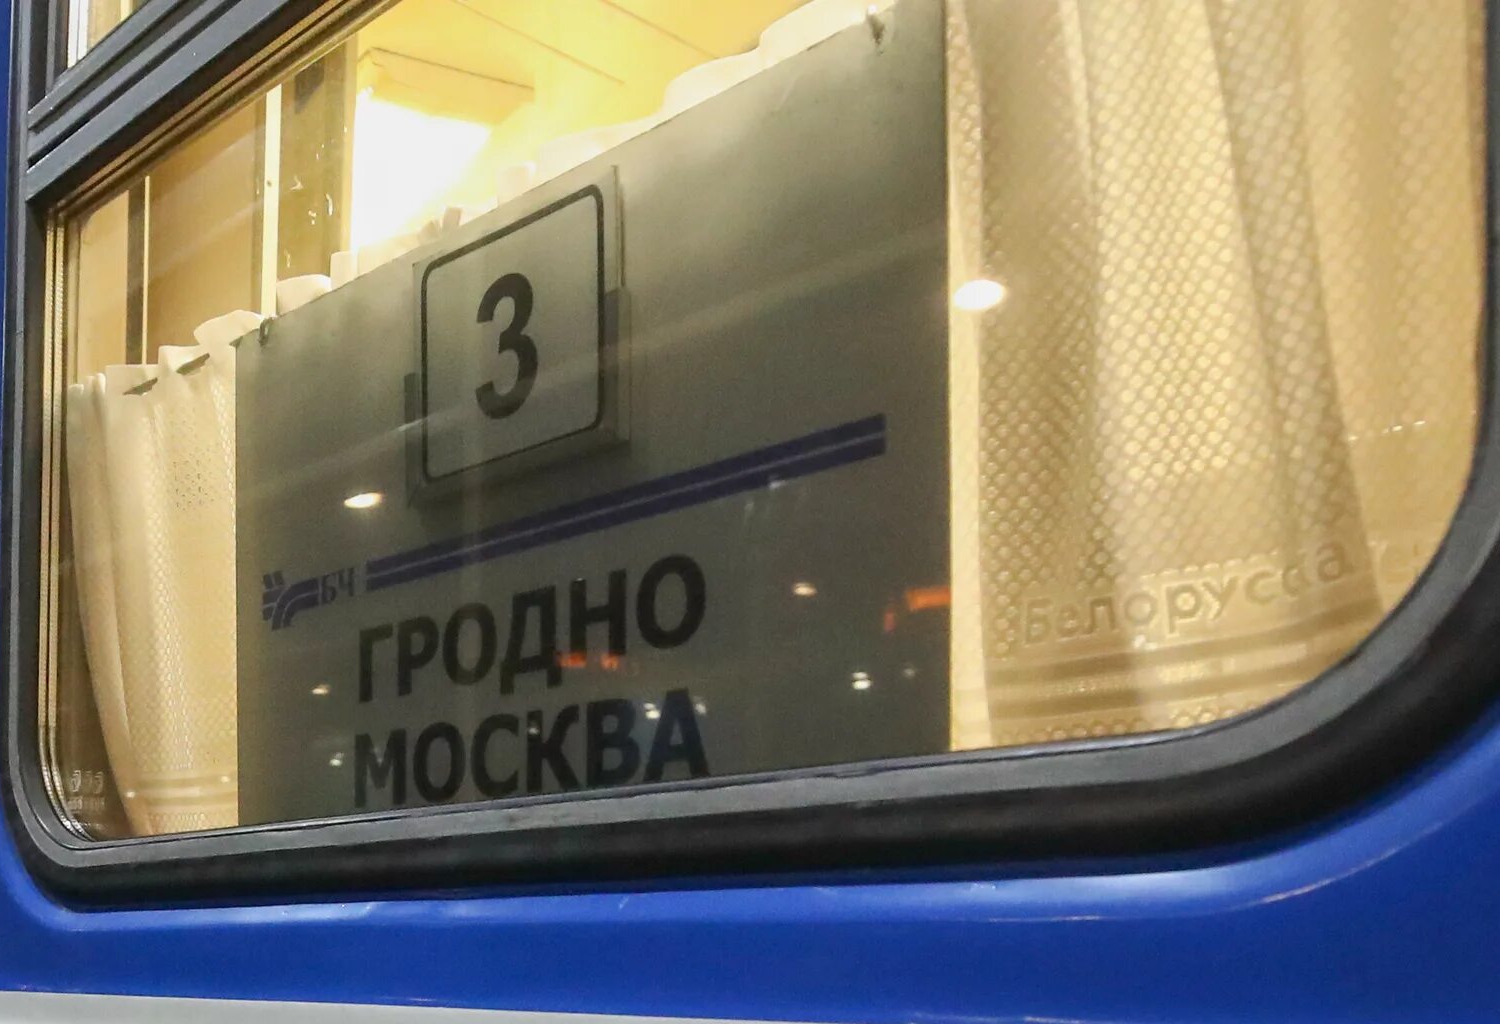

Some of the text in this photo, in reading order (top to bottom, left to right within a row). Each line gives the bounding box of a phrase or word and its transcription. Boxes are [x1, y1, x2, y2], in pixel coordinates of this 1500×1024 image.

[476, 273, 538, 419] 3
[321, 568, 355, 606] БЧ
[359, 554, 707, 703] ГРОДНО
[354, 688, 710, 808] МОСКВА
